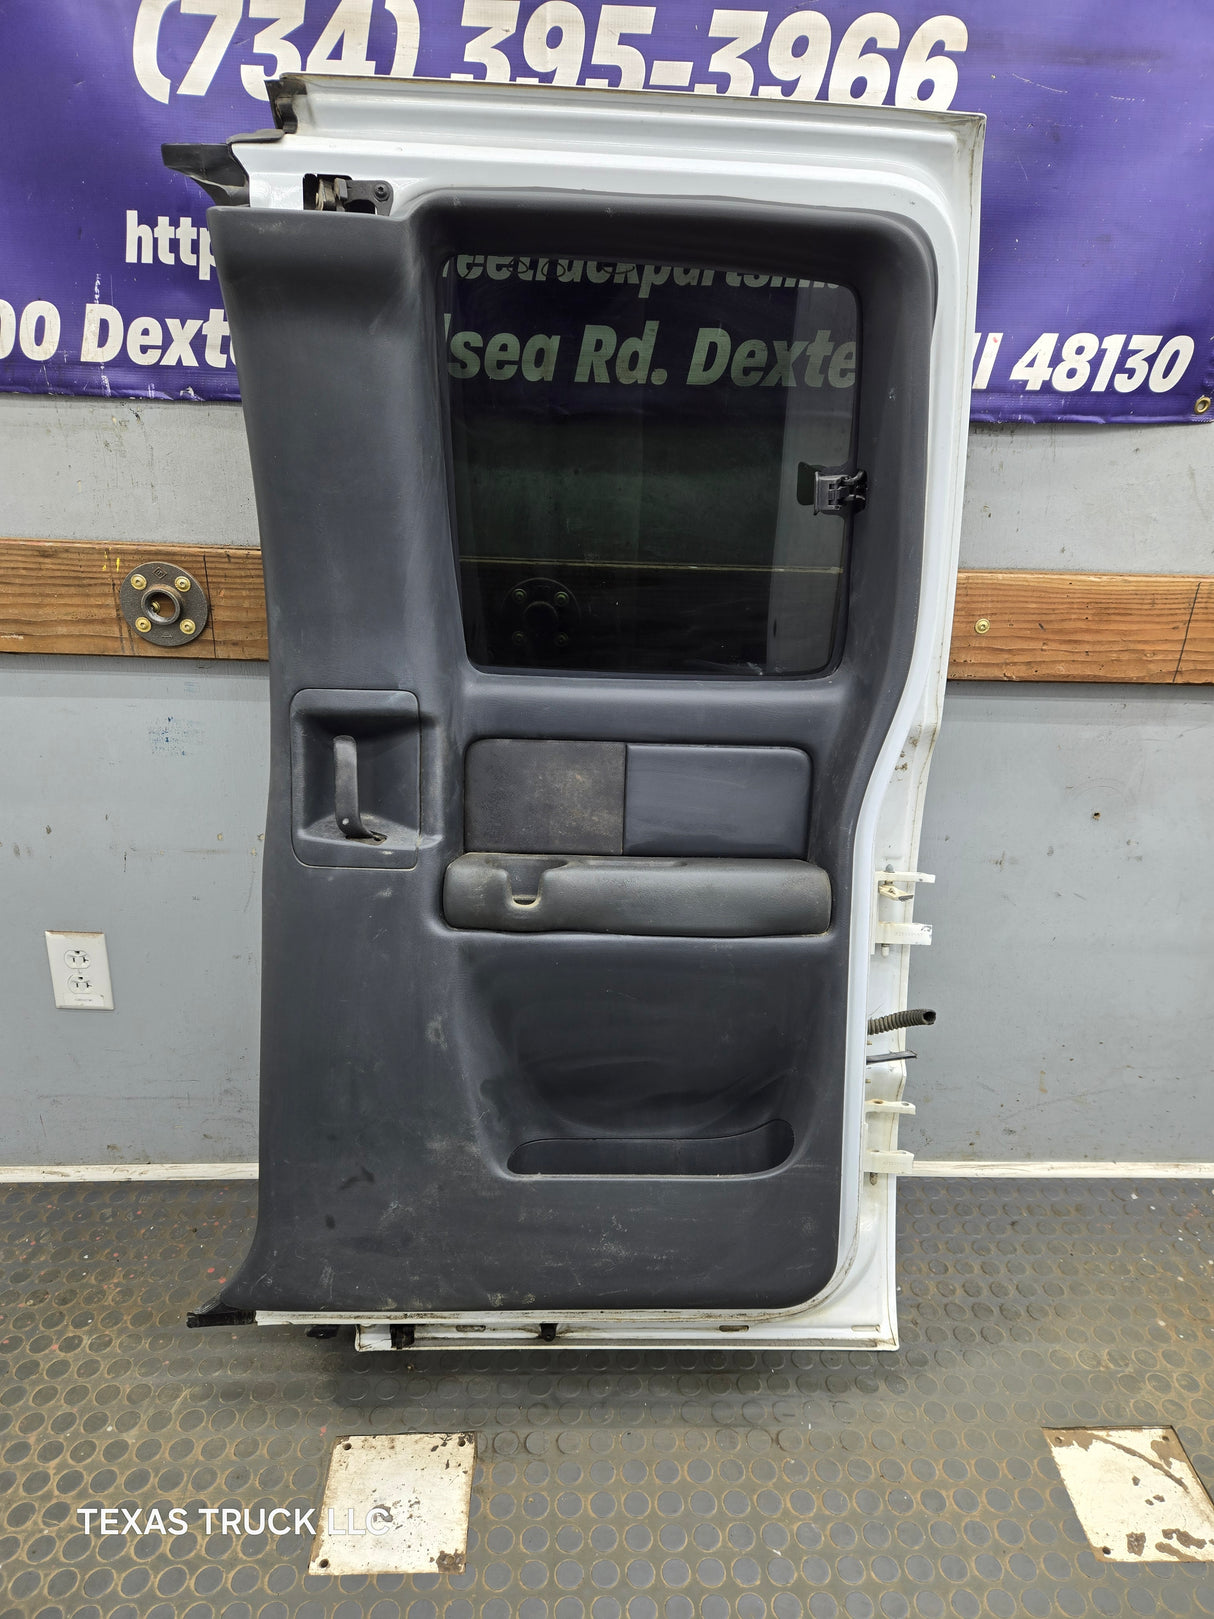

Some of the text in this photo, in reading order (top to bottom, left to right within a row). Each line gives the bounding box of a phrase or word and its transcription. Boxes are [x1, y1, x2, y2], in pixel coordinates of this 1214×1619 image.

[133, 0, 969, 112] (734) 395-3966
[80, 302, 238, 369] Dext
[443, 313, 561, 382] sea
[574, 320, 668, 386] Rd.
[1009, 332, 1195, 393] 48130
